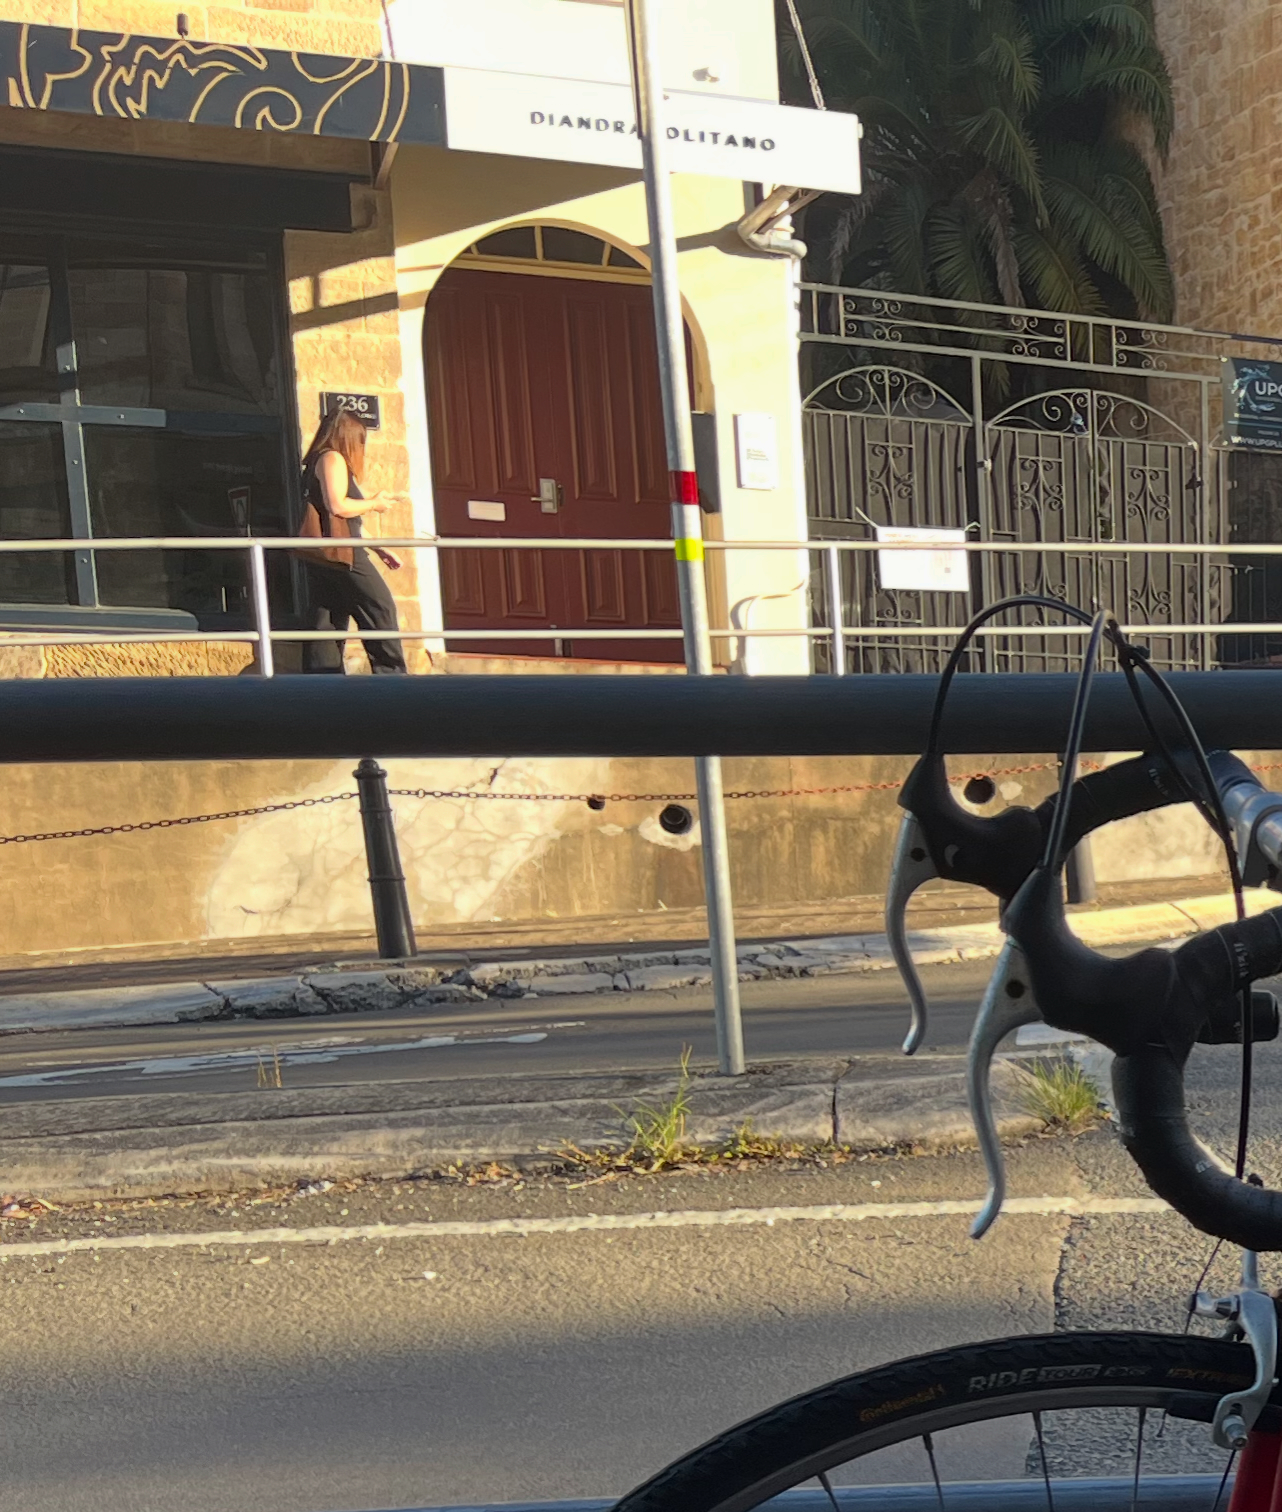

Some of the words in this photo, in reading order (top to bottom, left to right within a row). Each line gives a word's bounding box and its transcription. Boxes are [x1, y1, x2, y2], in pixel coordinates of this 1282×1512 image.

[665, 126, 776, 151] OLITANO
[336, 395, 369, 412] 236
[968, 1367, 1037, 1393] RIDE
[1043, 1365, 1098, 1380] TOUR
